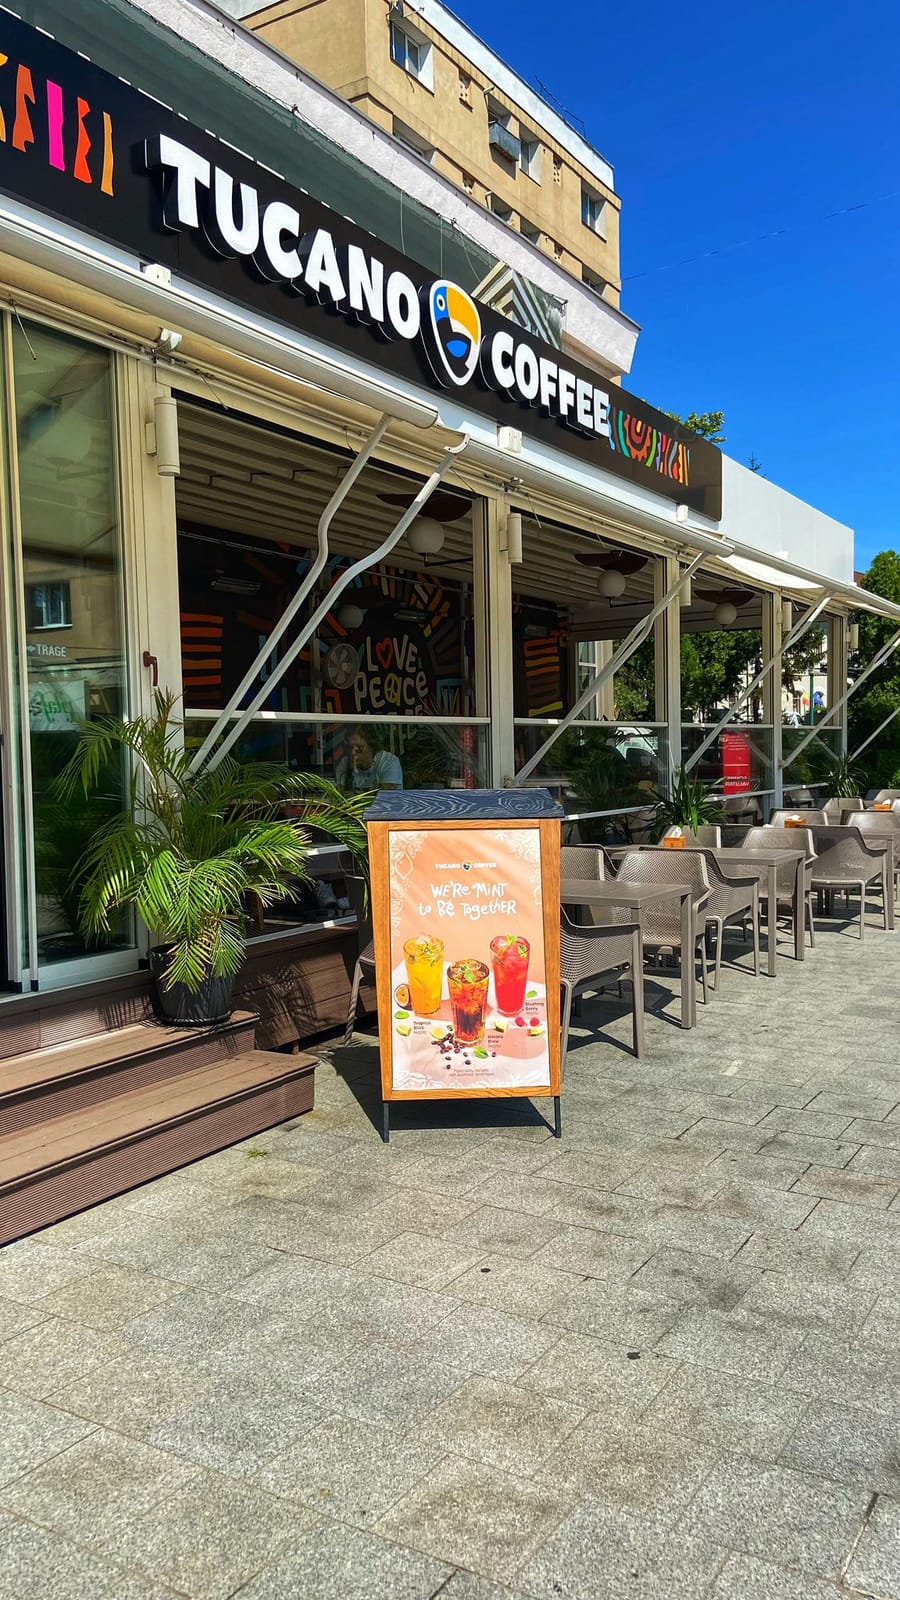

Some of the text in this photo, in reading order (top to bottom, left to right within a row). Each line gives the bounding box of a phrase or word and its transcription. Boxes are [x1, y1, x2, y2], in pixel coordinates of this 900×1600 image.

[158, 132, 610, 438] TUCANO COFFEE
[36, 643, 67, 657] TRAGE
[418, 902, 432, 916] to
